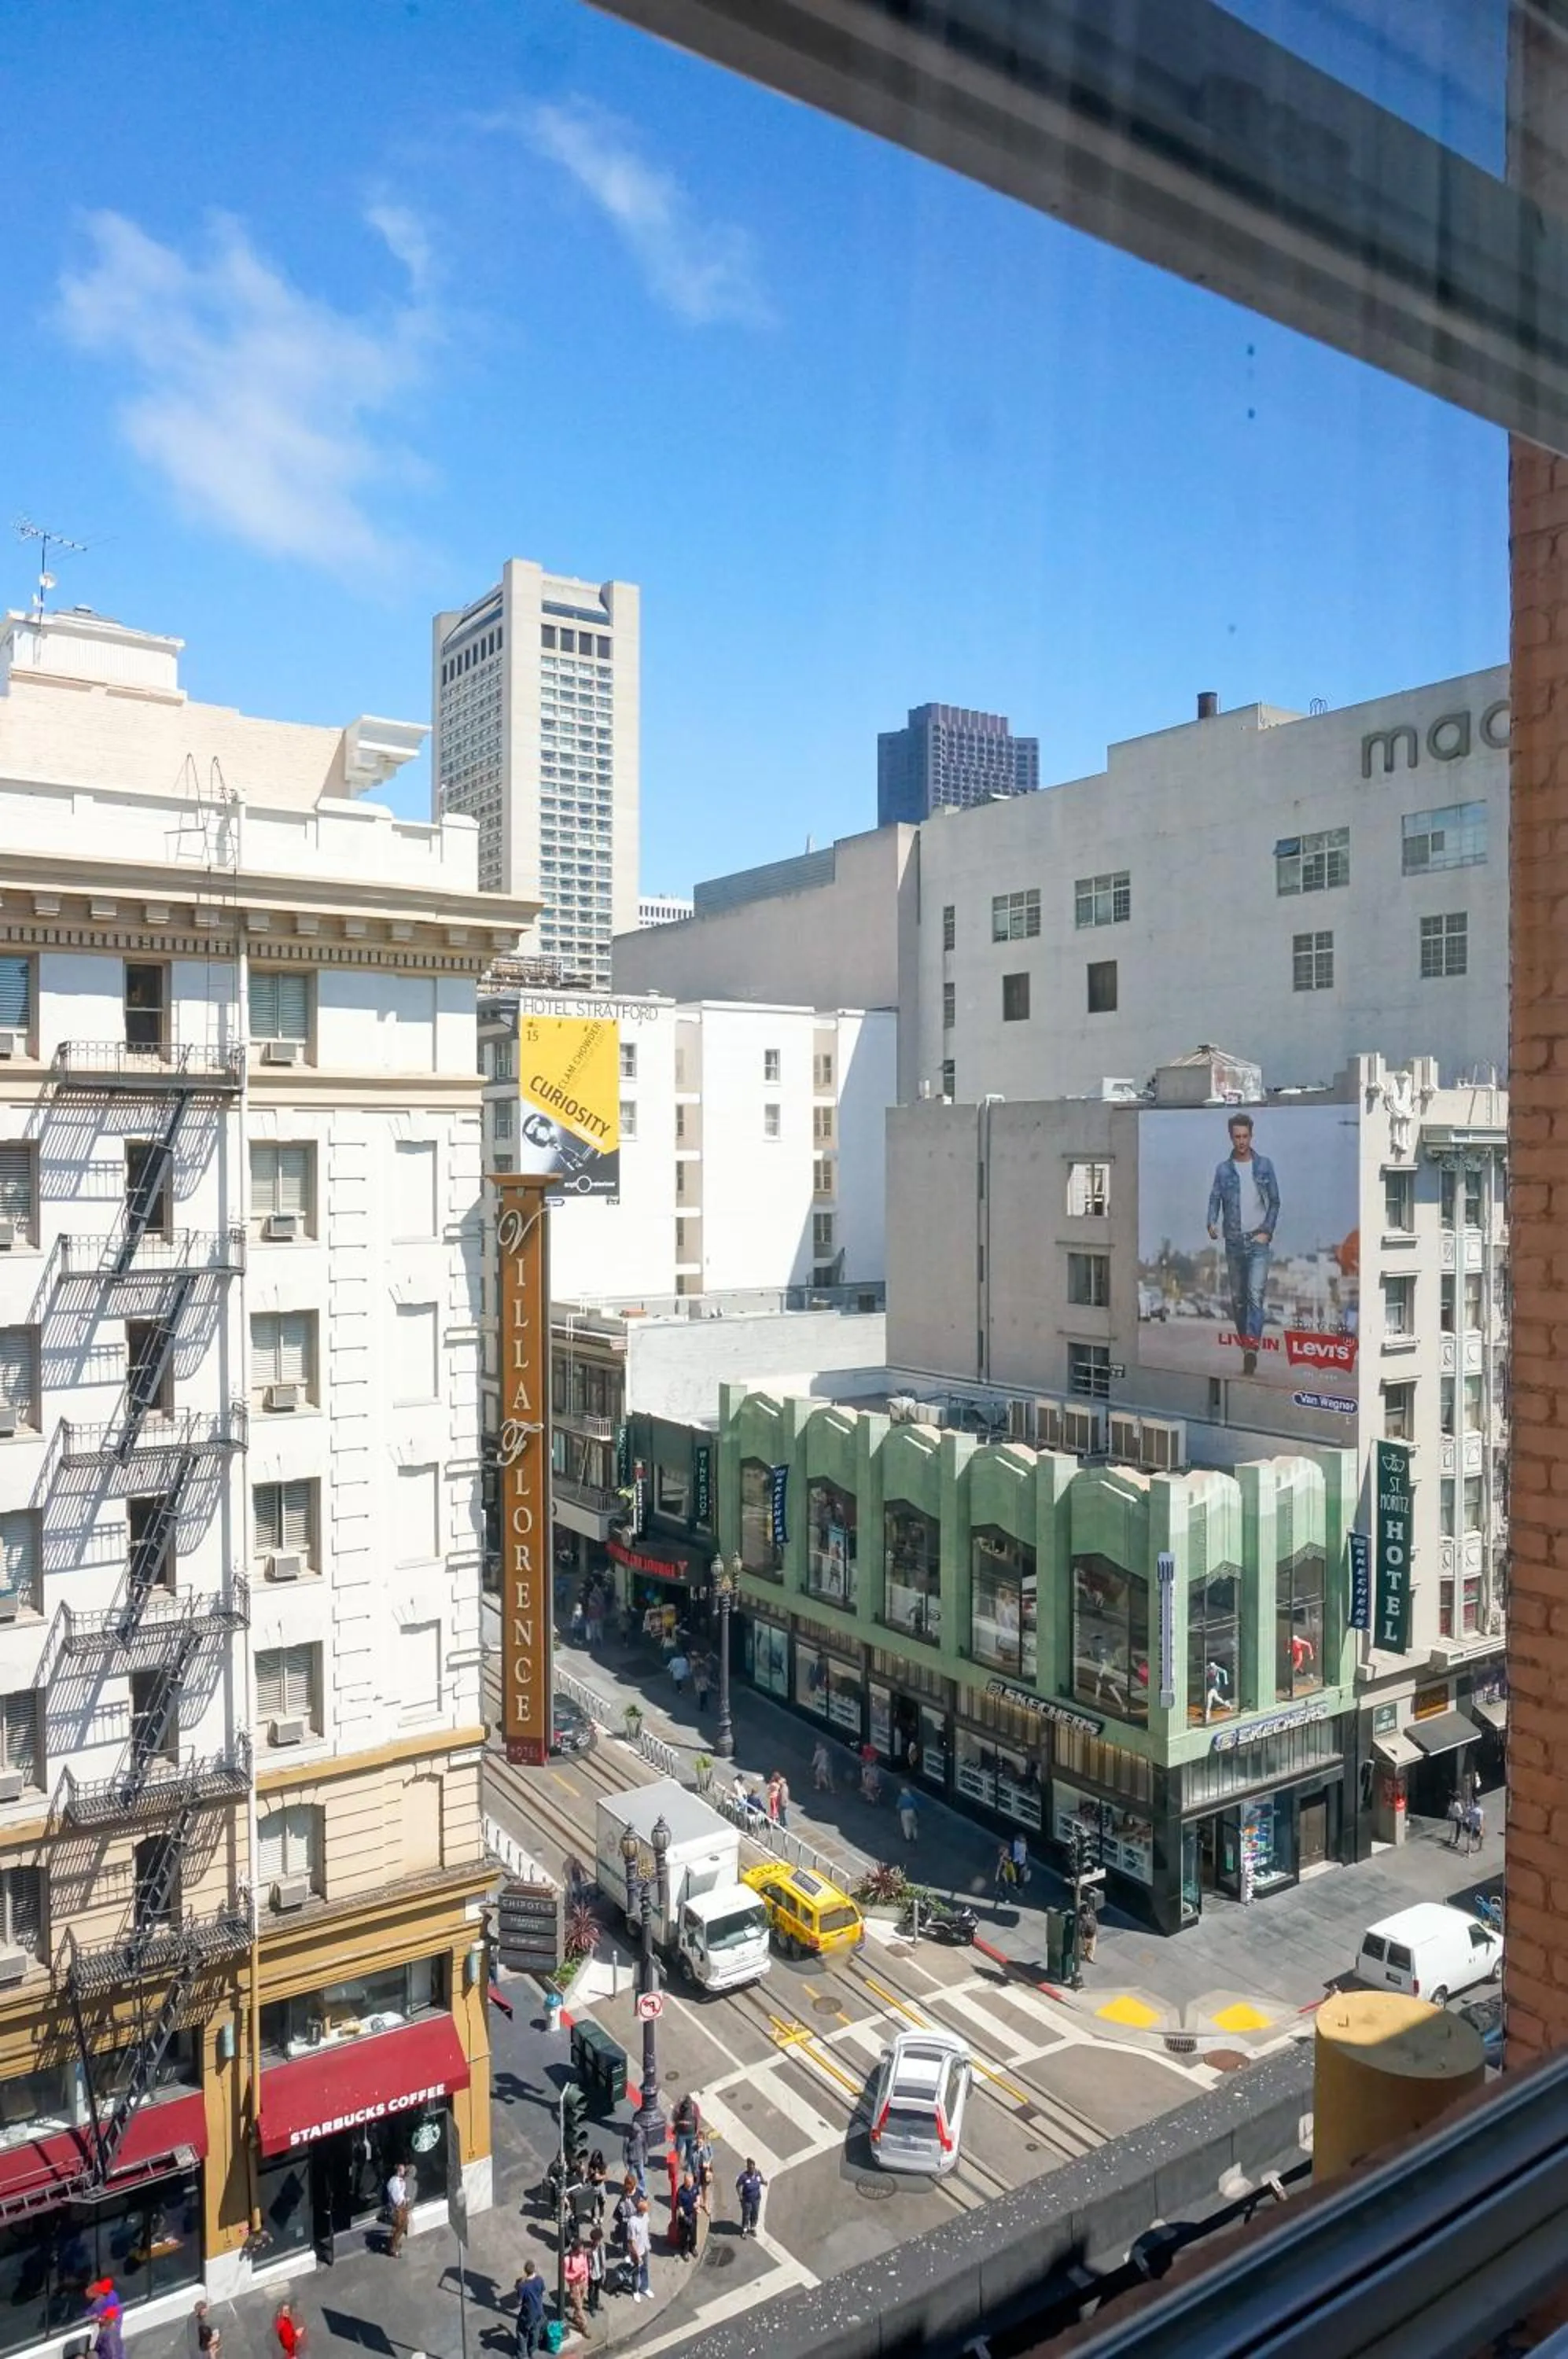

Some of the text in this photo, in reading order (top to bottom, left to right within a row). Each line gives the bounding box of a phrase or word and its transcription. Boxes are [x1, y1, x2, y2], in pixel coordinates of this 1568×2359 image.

[523, 999, 658, 1021] HOTEL STRATFORD
[529, 1075, 611, 1138] CURIOSITY
[1261, 1337, 1279, 1351] IN
[497, 1207, 550, 1721] VILLA FLORENCE
[1384, 1520, 1404, 1642] HOTEL
[1003, 1687, 1101, 1736] SKECHERS
[290, 2083, 446, 2146] STARBUCKS COFFEE
